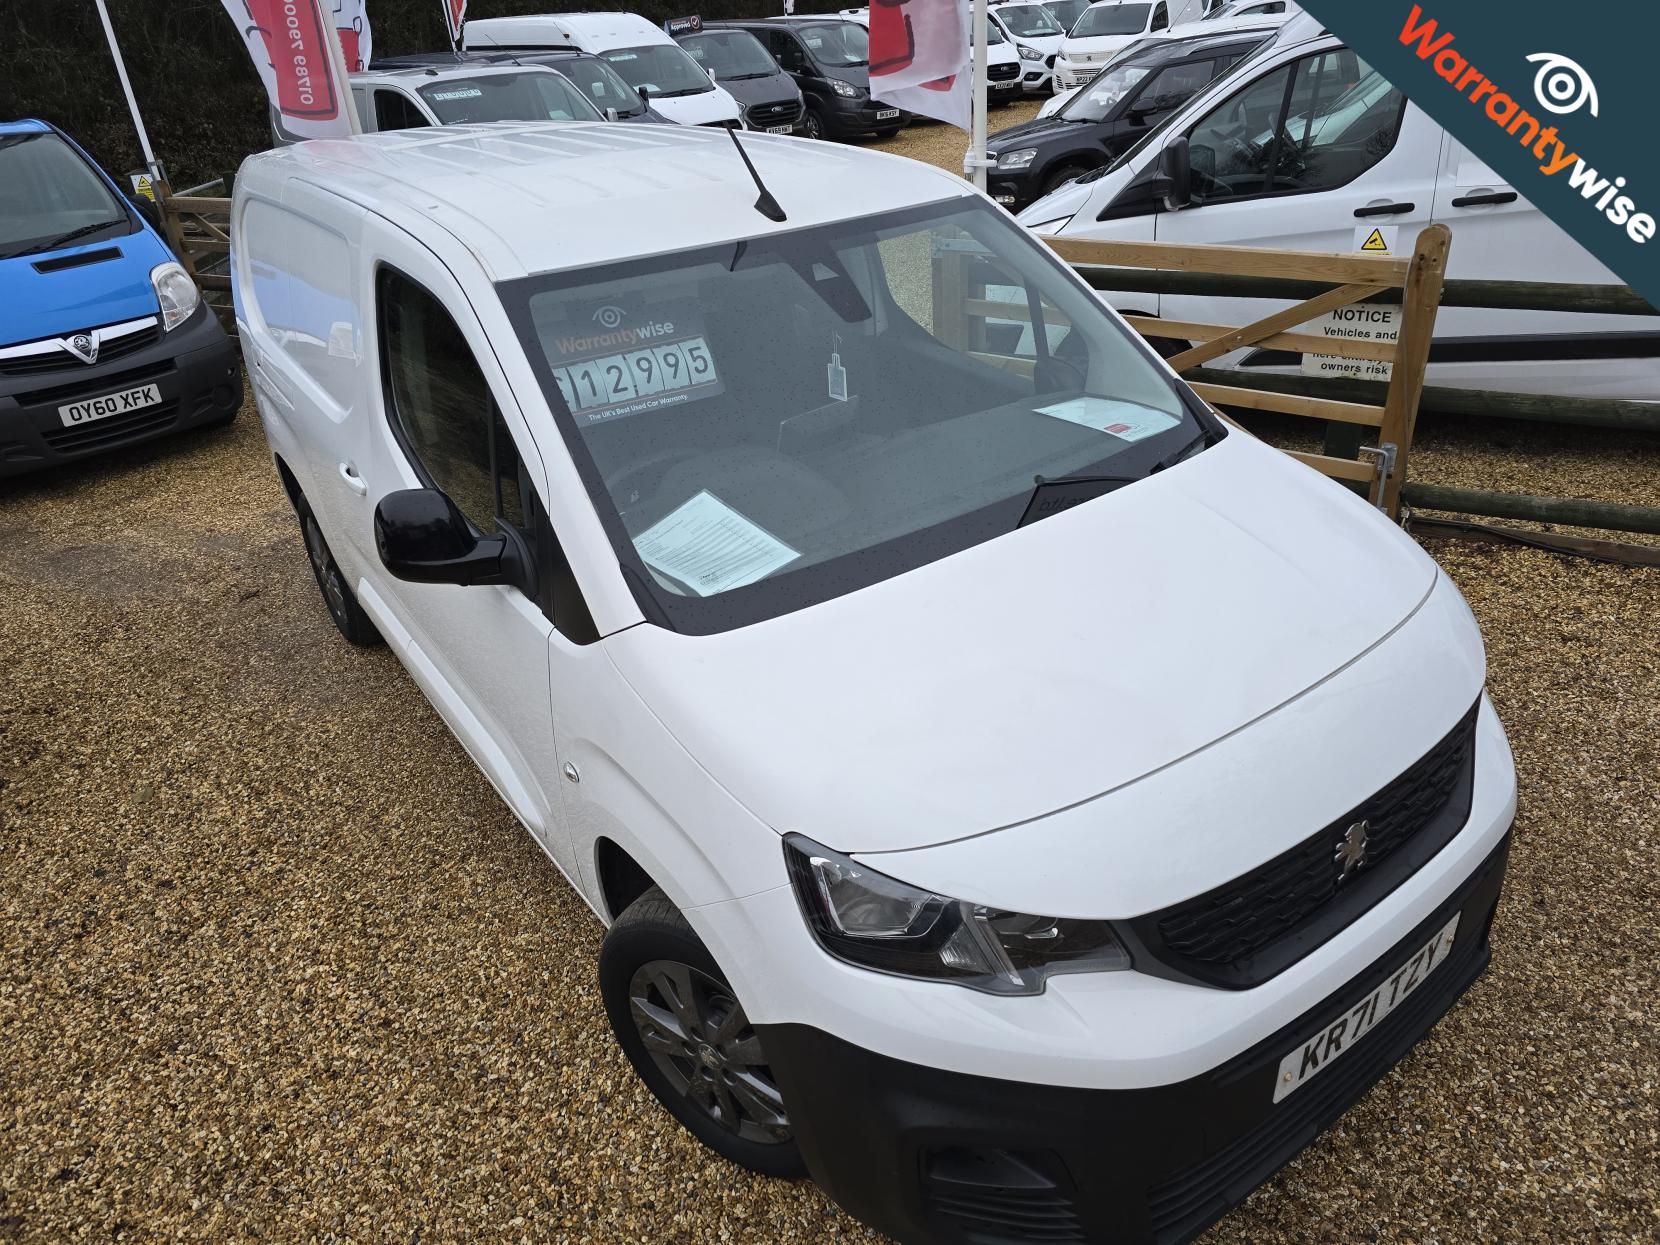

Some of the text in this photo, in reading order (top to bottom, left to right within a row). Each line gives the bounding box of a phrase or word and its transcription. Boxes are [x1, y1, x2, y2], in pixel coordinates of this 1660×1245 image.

[671, 22, 691, 31] Approved
[1333, 308, 1392, 323] NOTICE
[556, 321, 674, 354] Warrantywise
[1324, 326, 1397, 340] Vehicles and
[1320, 362, 1388, 375] owners risk
[69, 387, 155, 422] OY60 XFK
[589, 412, 601, 421] The
[616, 405, 630, 415] Best
[631, 402, 647, 412] Used
[647, 399, 659, 408] Car
[1299, 931, 1444, 1081] KR71 TZY
